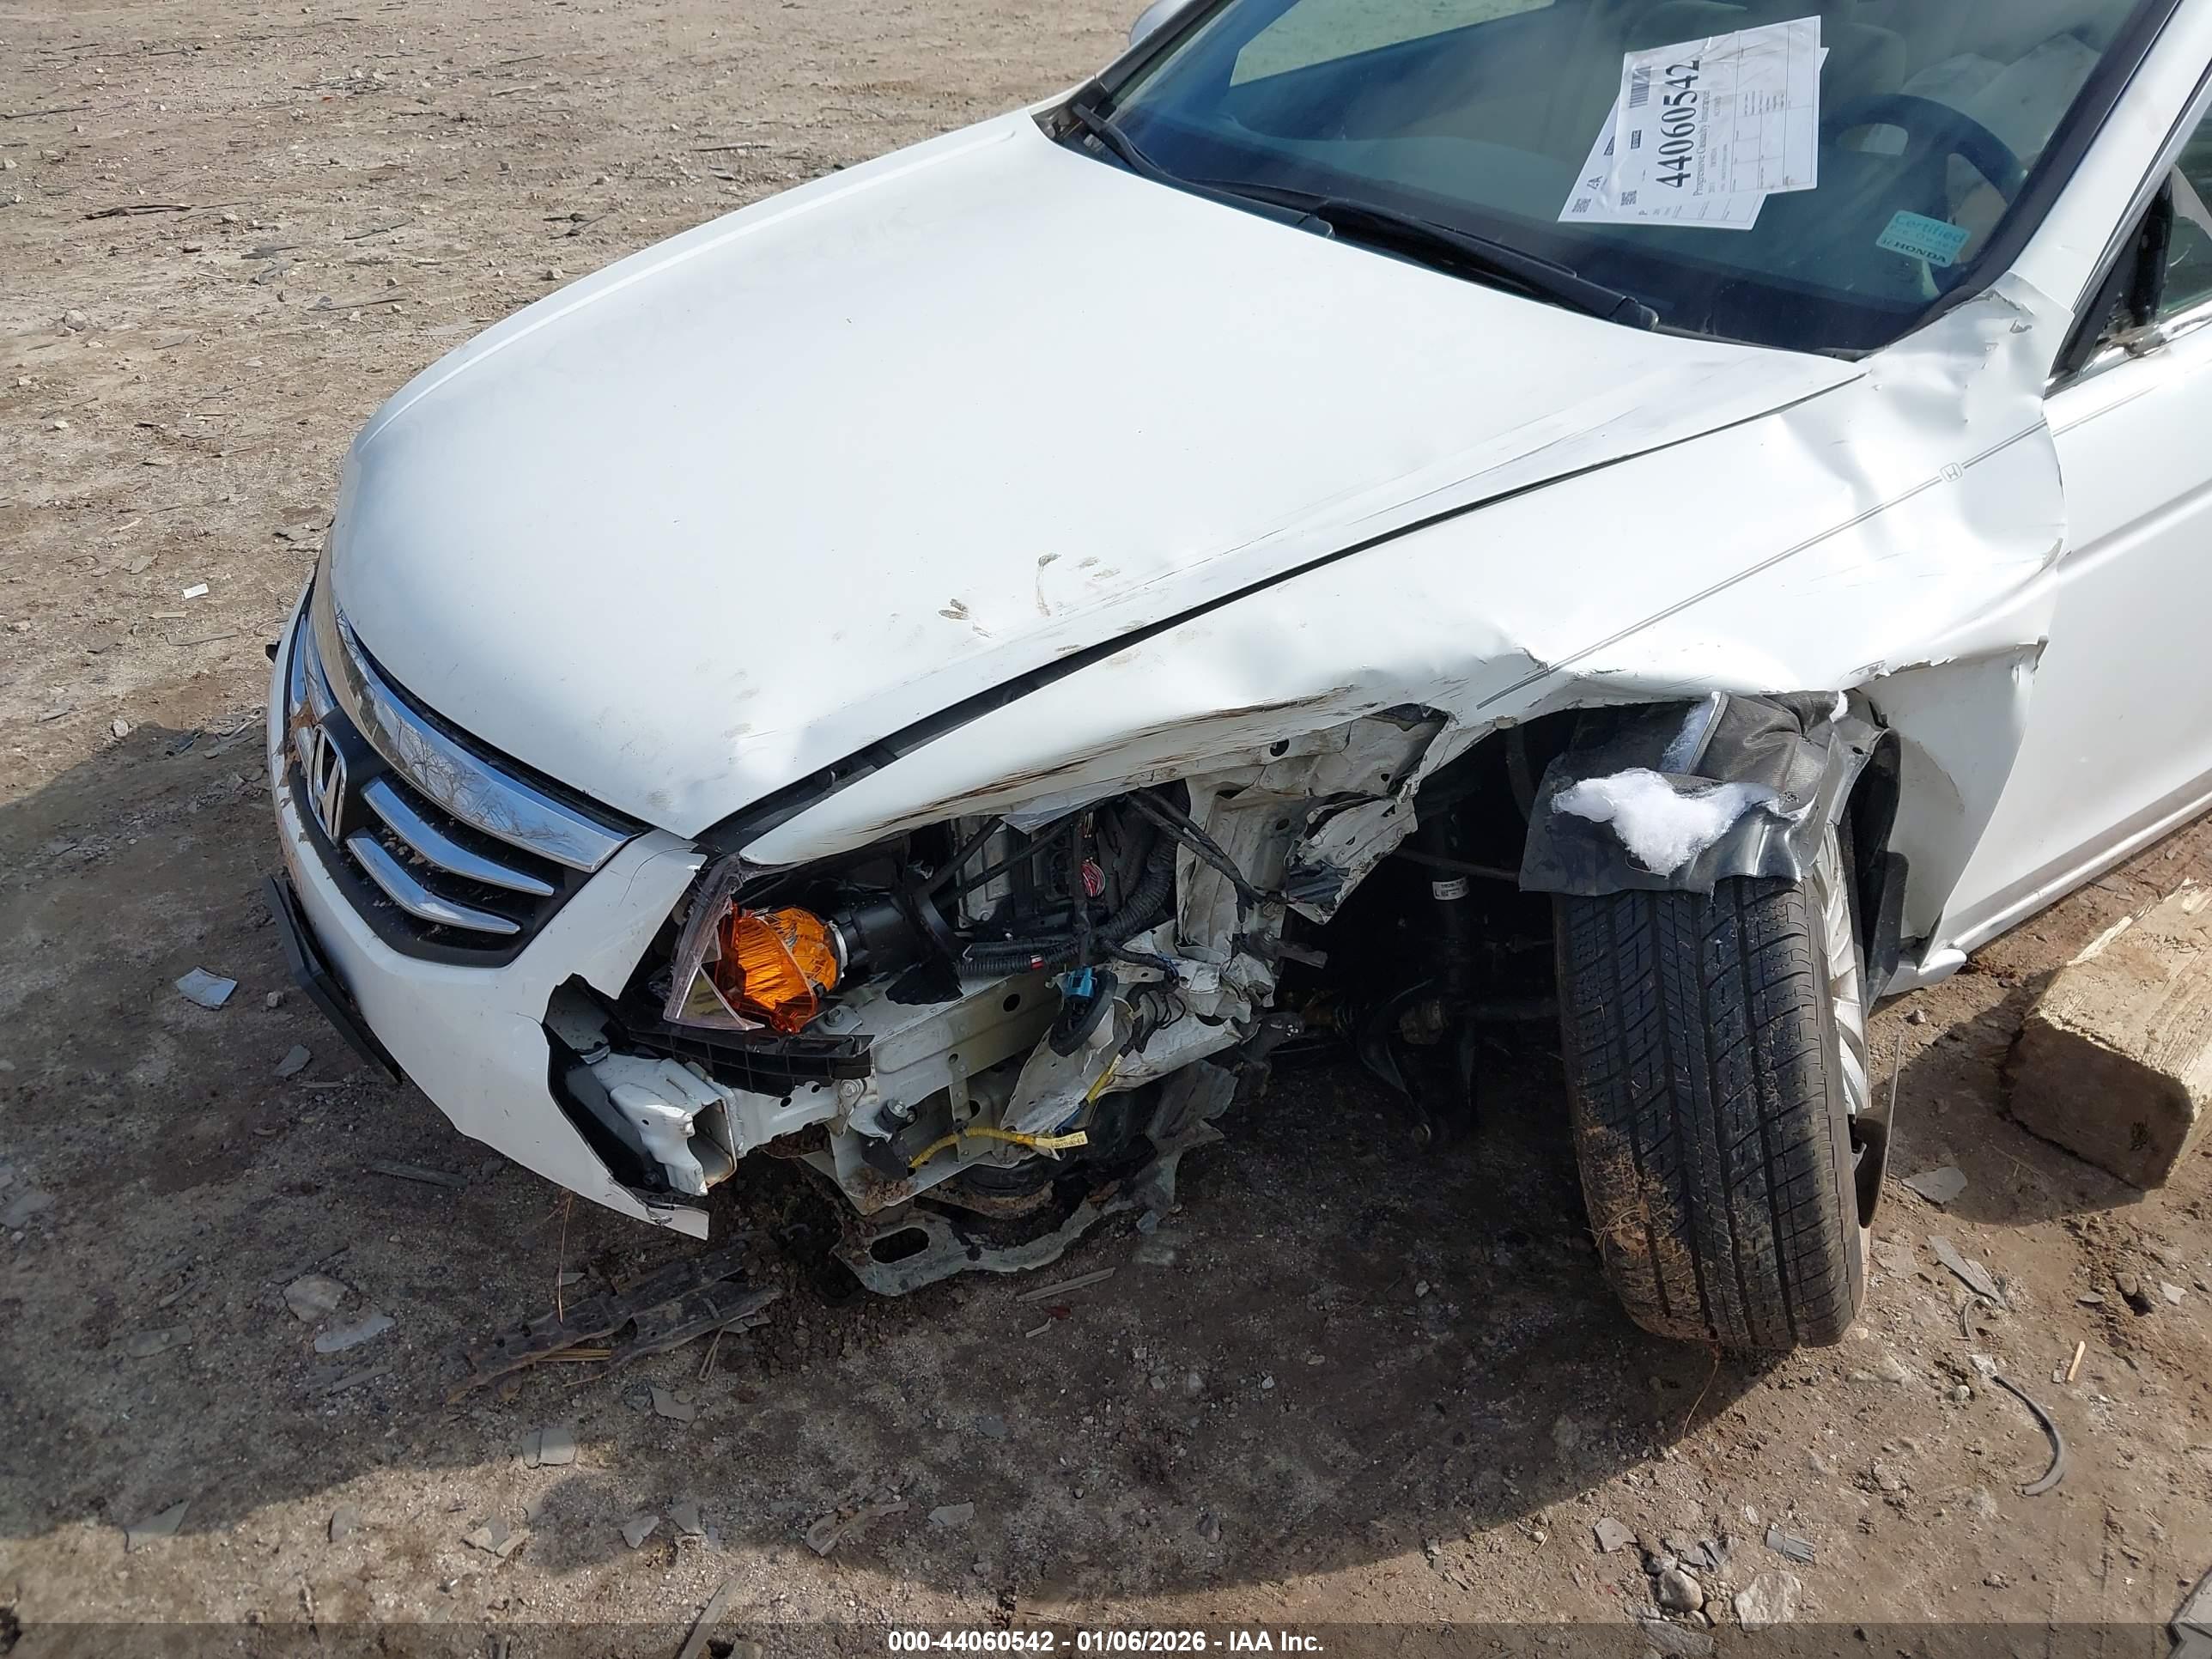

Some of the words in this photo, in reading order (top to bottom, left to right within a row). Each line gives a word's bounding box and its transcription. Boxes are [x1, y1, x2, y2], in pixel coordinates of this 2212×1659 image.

[1656, 60, 1700, 188] 44060542
[1895, 215, 1968, 244] Certified
[1893, 241, 1947, 263] HONDA
